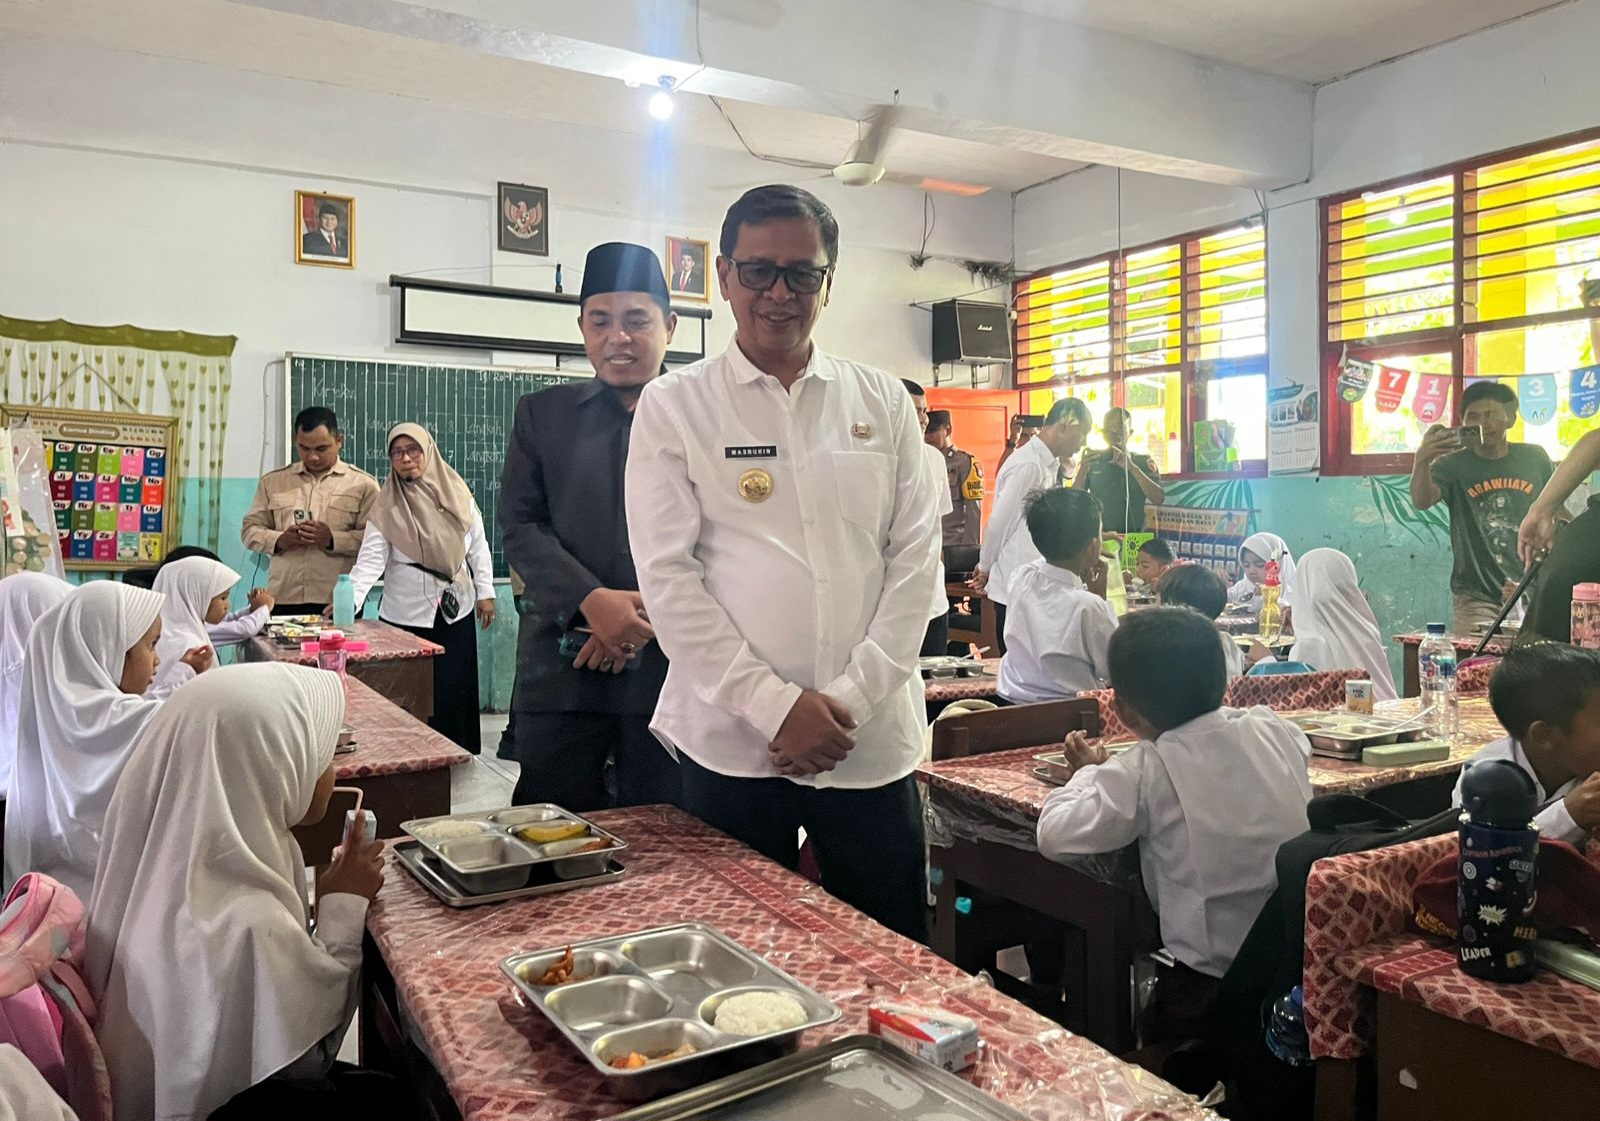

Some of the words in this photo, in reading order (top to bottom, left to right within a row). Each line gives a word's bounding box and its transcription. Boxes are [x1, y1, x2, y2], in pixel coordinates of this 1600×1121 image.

[1388, 371, 1402, 389] 7
[1426, 379, 1440, 395] 1
[1527, 379, 1545, 397] 3
[1580, 371, 1597, 389] 4
[731, 448, 771, 456] MASRUKIN
[1460, 947, 1492, 962] LEADER
